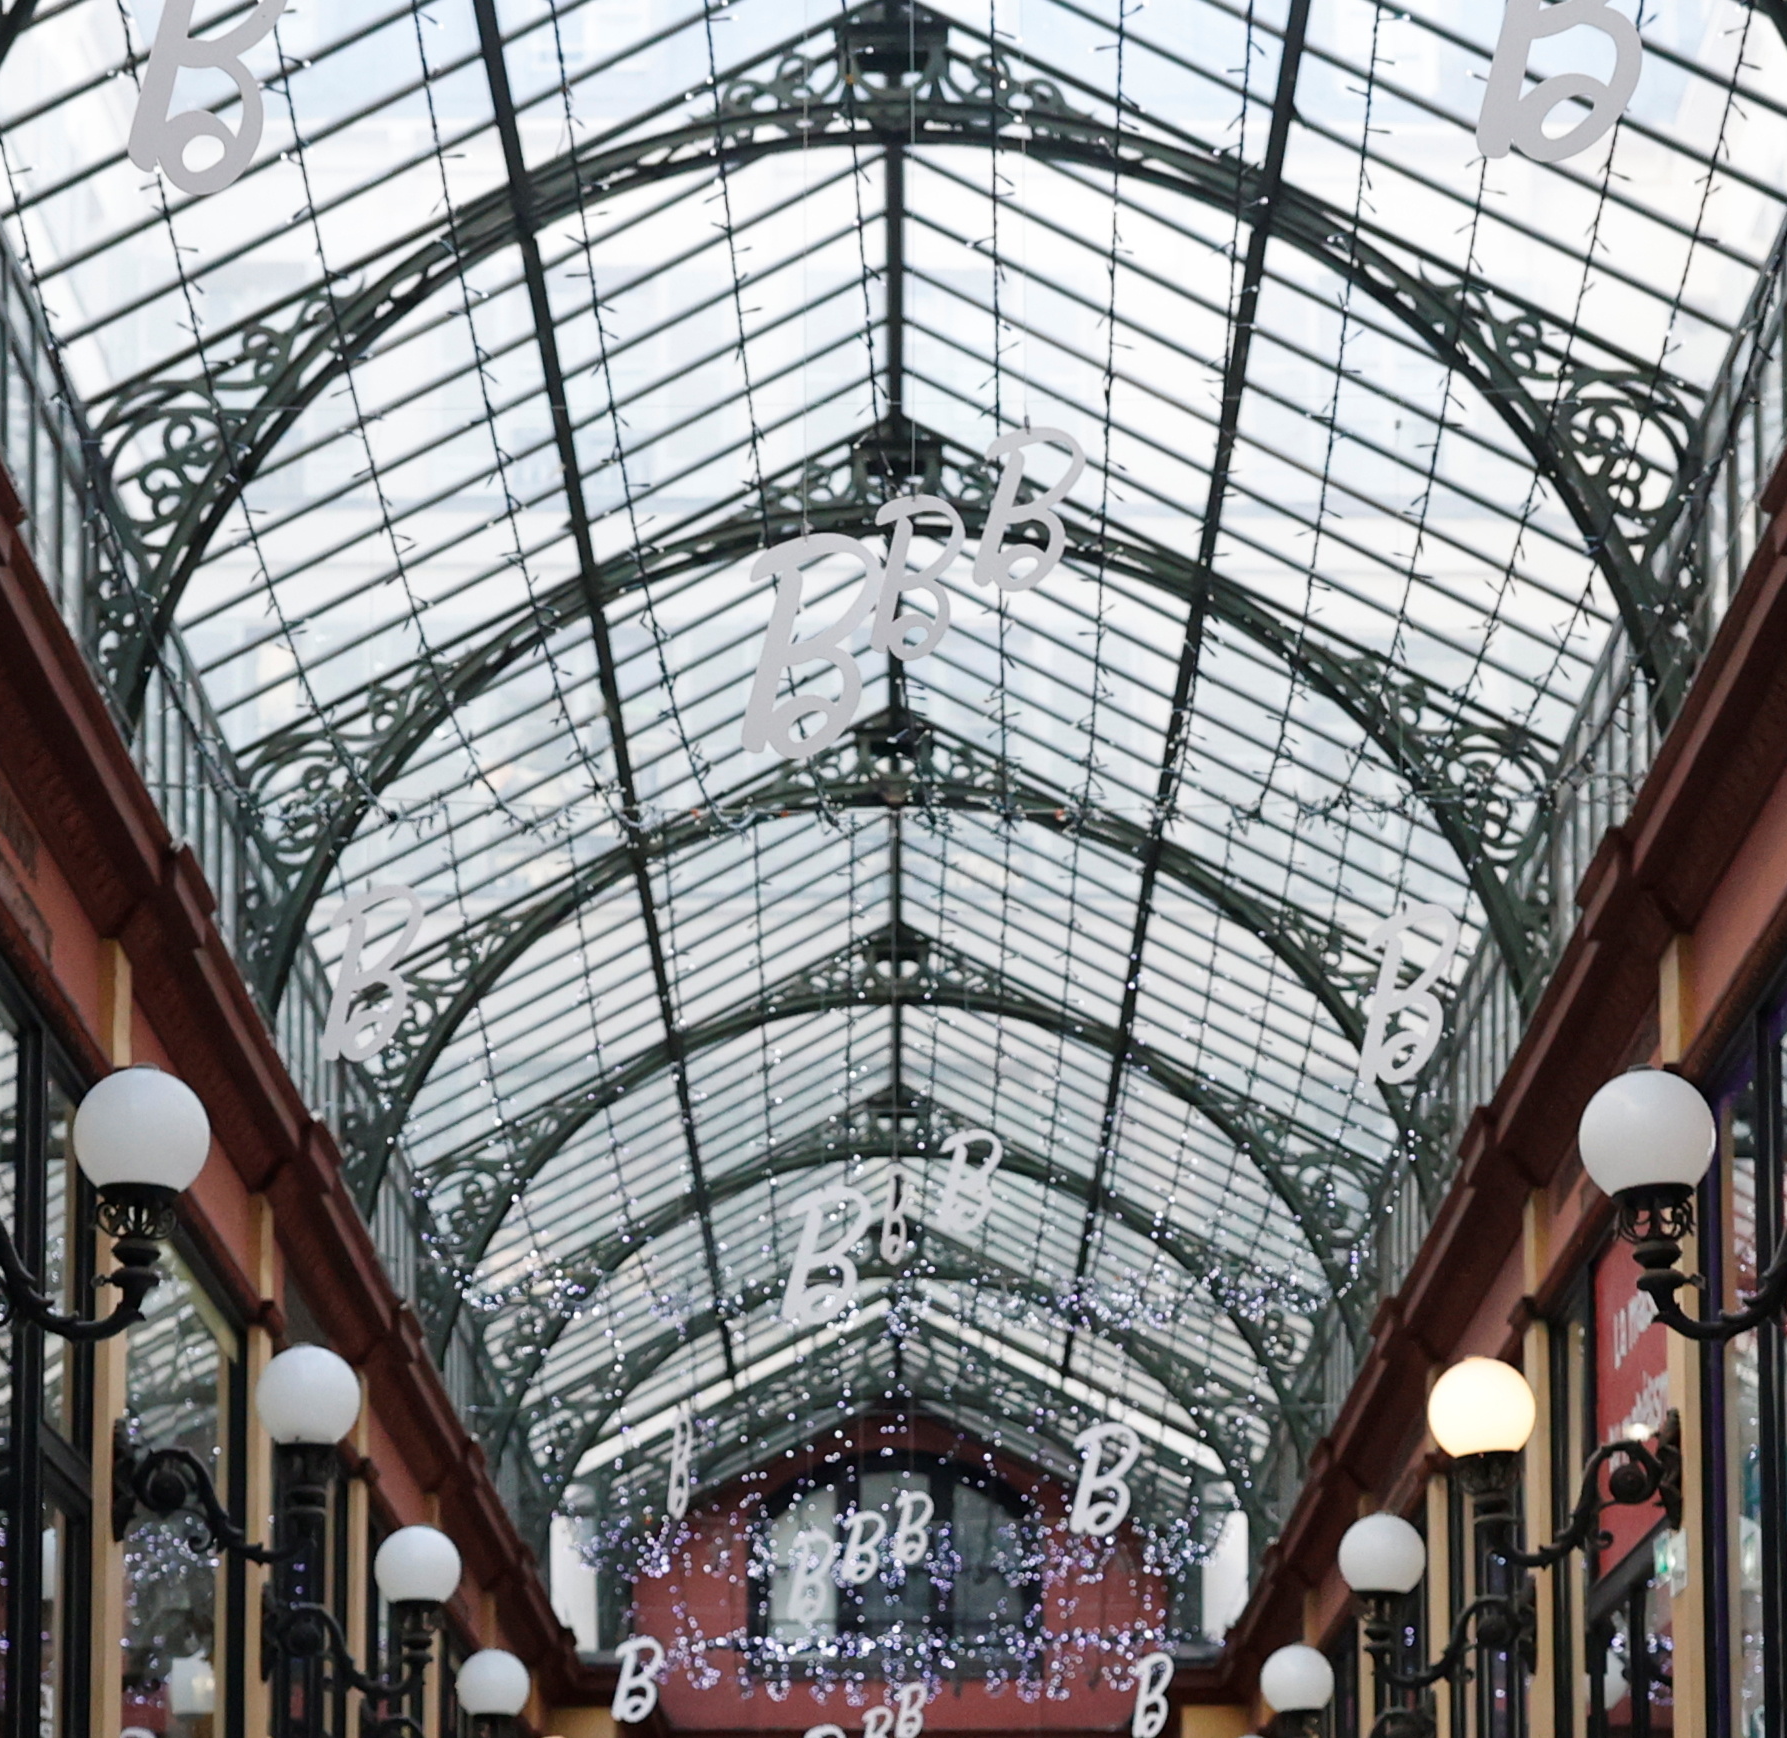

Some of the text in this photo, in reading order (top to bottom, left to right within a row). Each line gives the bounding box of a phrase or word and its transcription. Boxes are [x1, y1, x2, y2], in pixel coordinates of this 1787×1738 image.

[870, 494, 966, 661] B
[972, 426, 1086, 592] B
[742, 532, 887, 759] B
[321, 884, 425, 1062] B
[1358, 901, 1459, 1085] B
[1068, 1422, 1141, 1536] B
[610, 1636, 666, 1722] B
